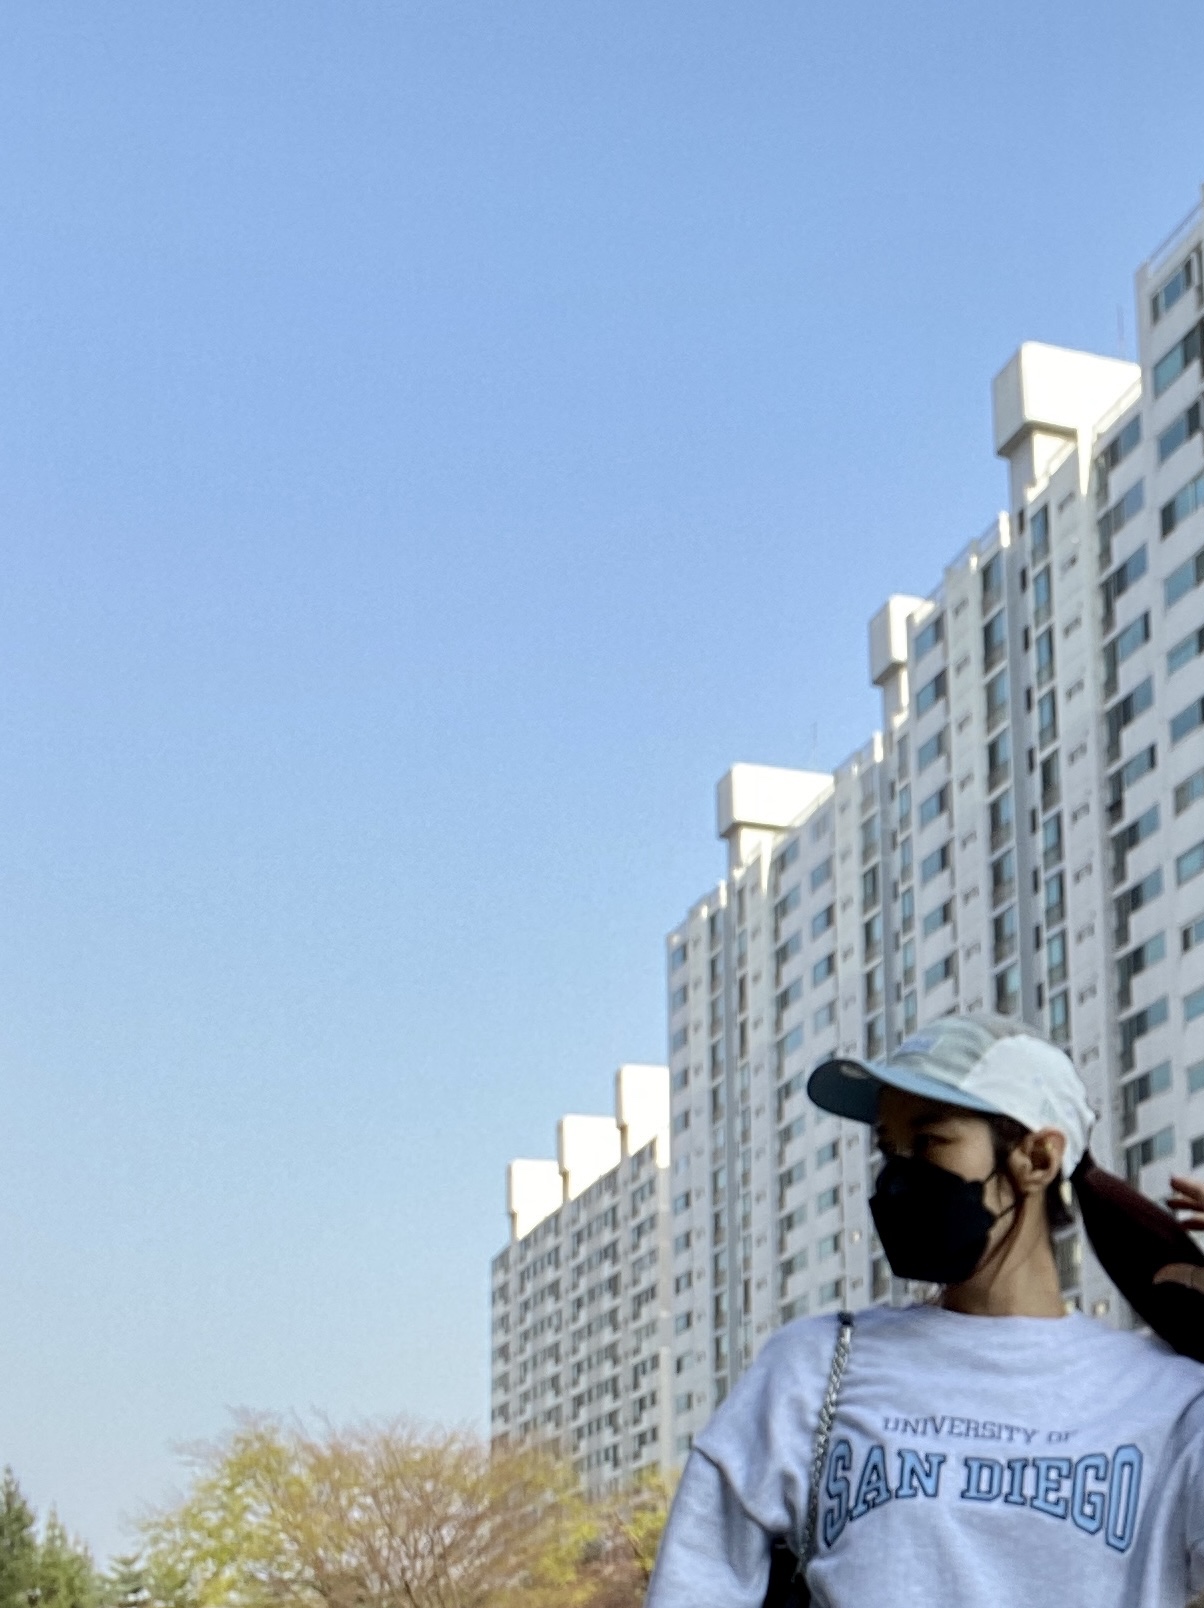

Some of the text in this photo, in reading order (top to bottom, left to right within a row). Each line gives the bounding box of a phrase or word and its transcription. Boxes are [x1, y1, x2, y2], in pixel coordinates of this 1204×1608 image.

[883, 1415, 1039, 1445] UNIVERSITY
[823, 1439, 1143, 1552] SAN DIEGO
